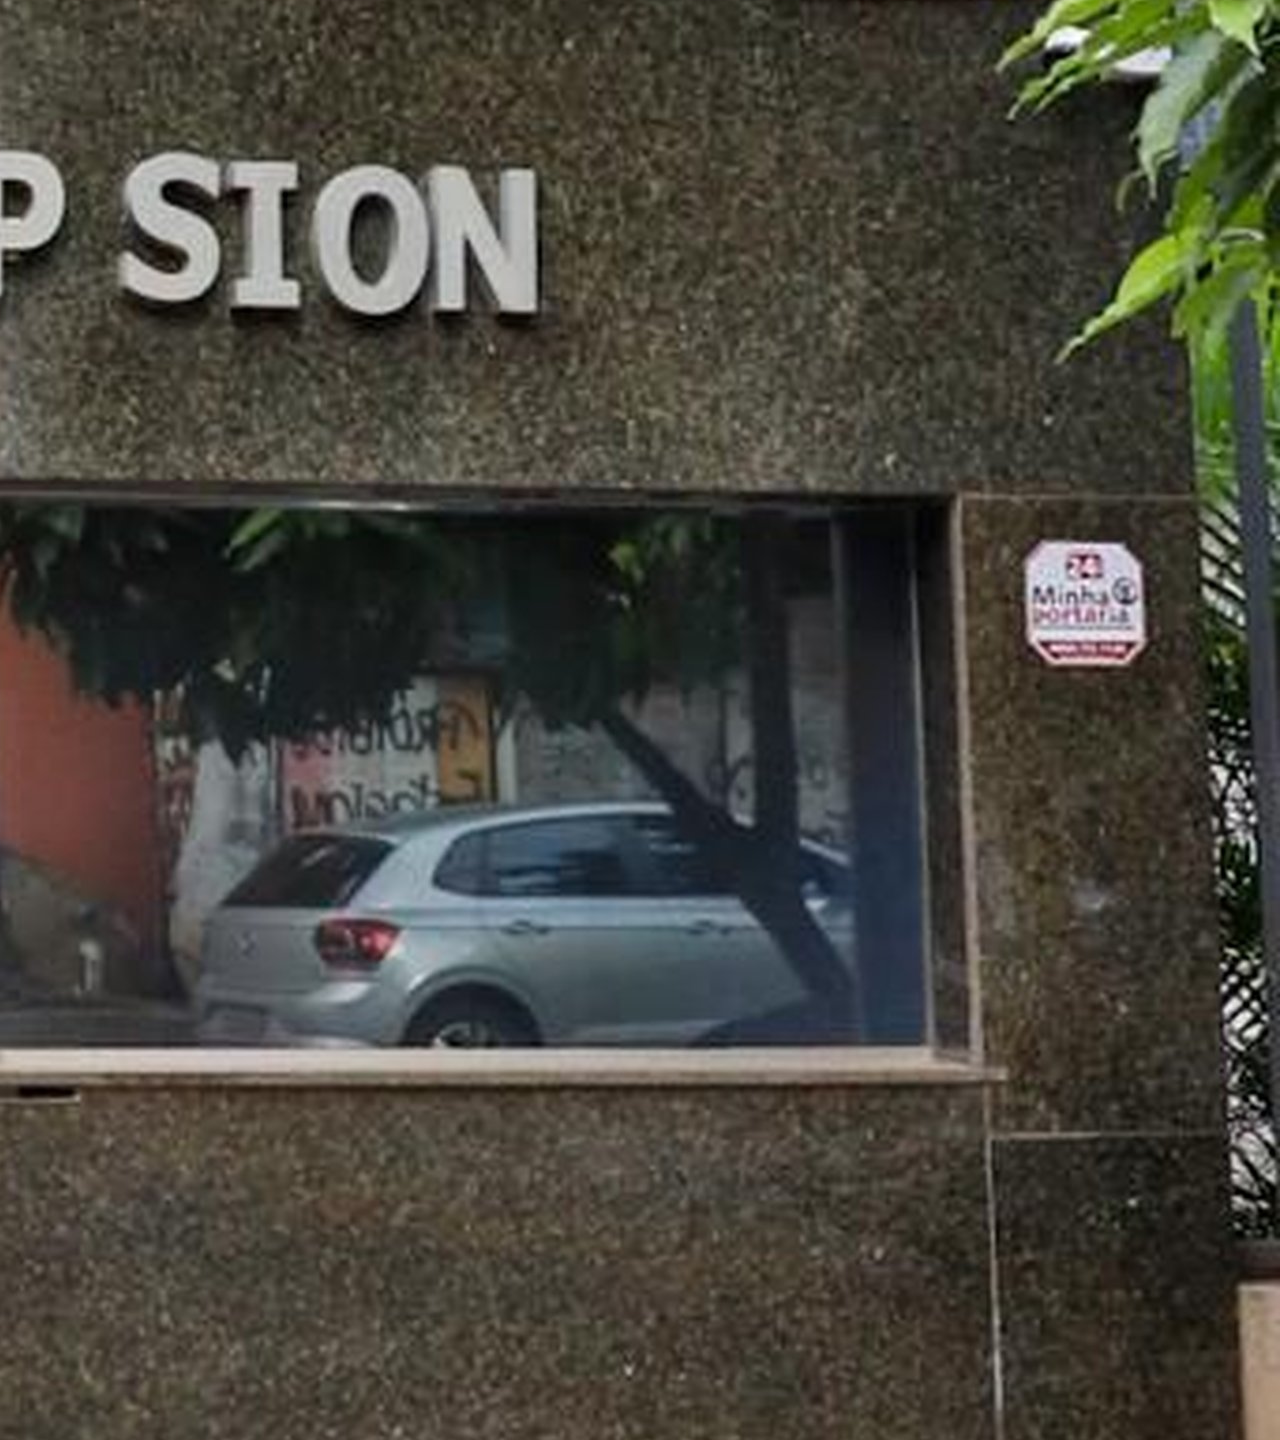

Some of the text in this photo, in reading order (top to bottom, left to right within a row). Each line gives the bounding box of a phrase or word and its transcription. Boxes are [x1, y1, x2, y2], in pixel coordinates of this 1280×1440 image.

[117, 149, 539, 316] SION
[1032, 583, 1110, 607] Minha
[1032, 607, 1131, 624] portaria
